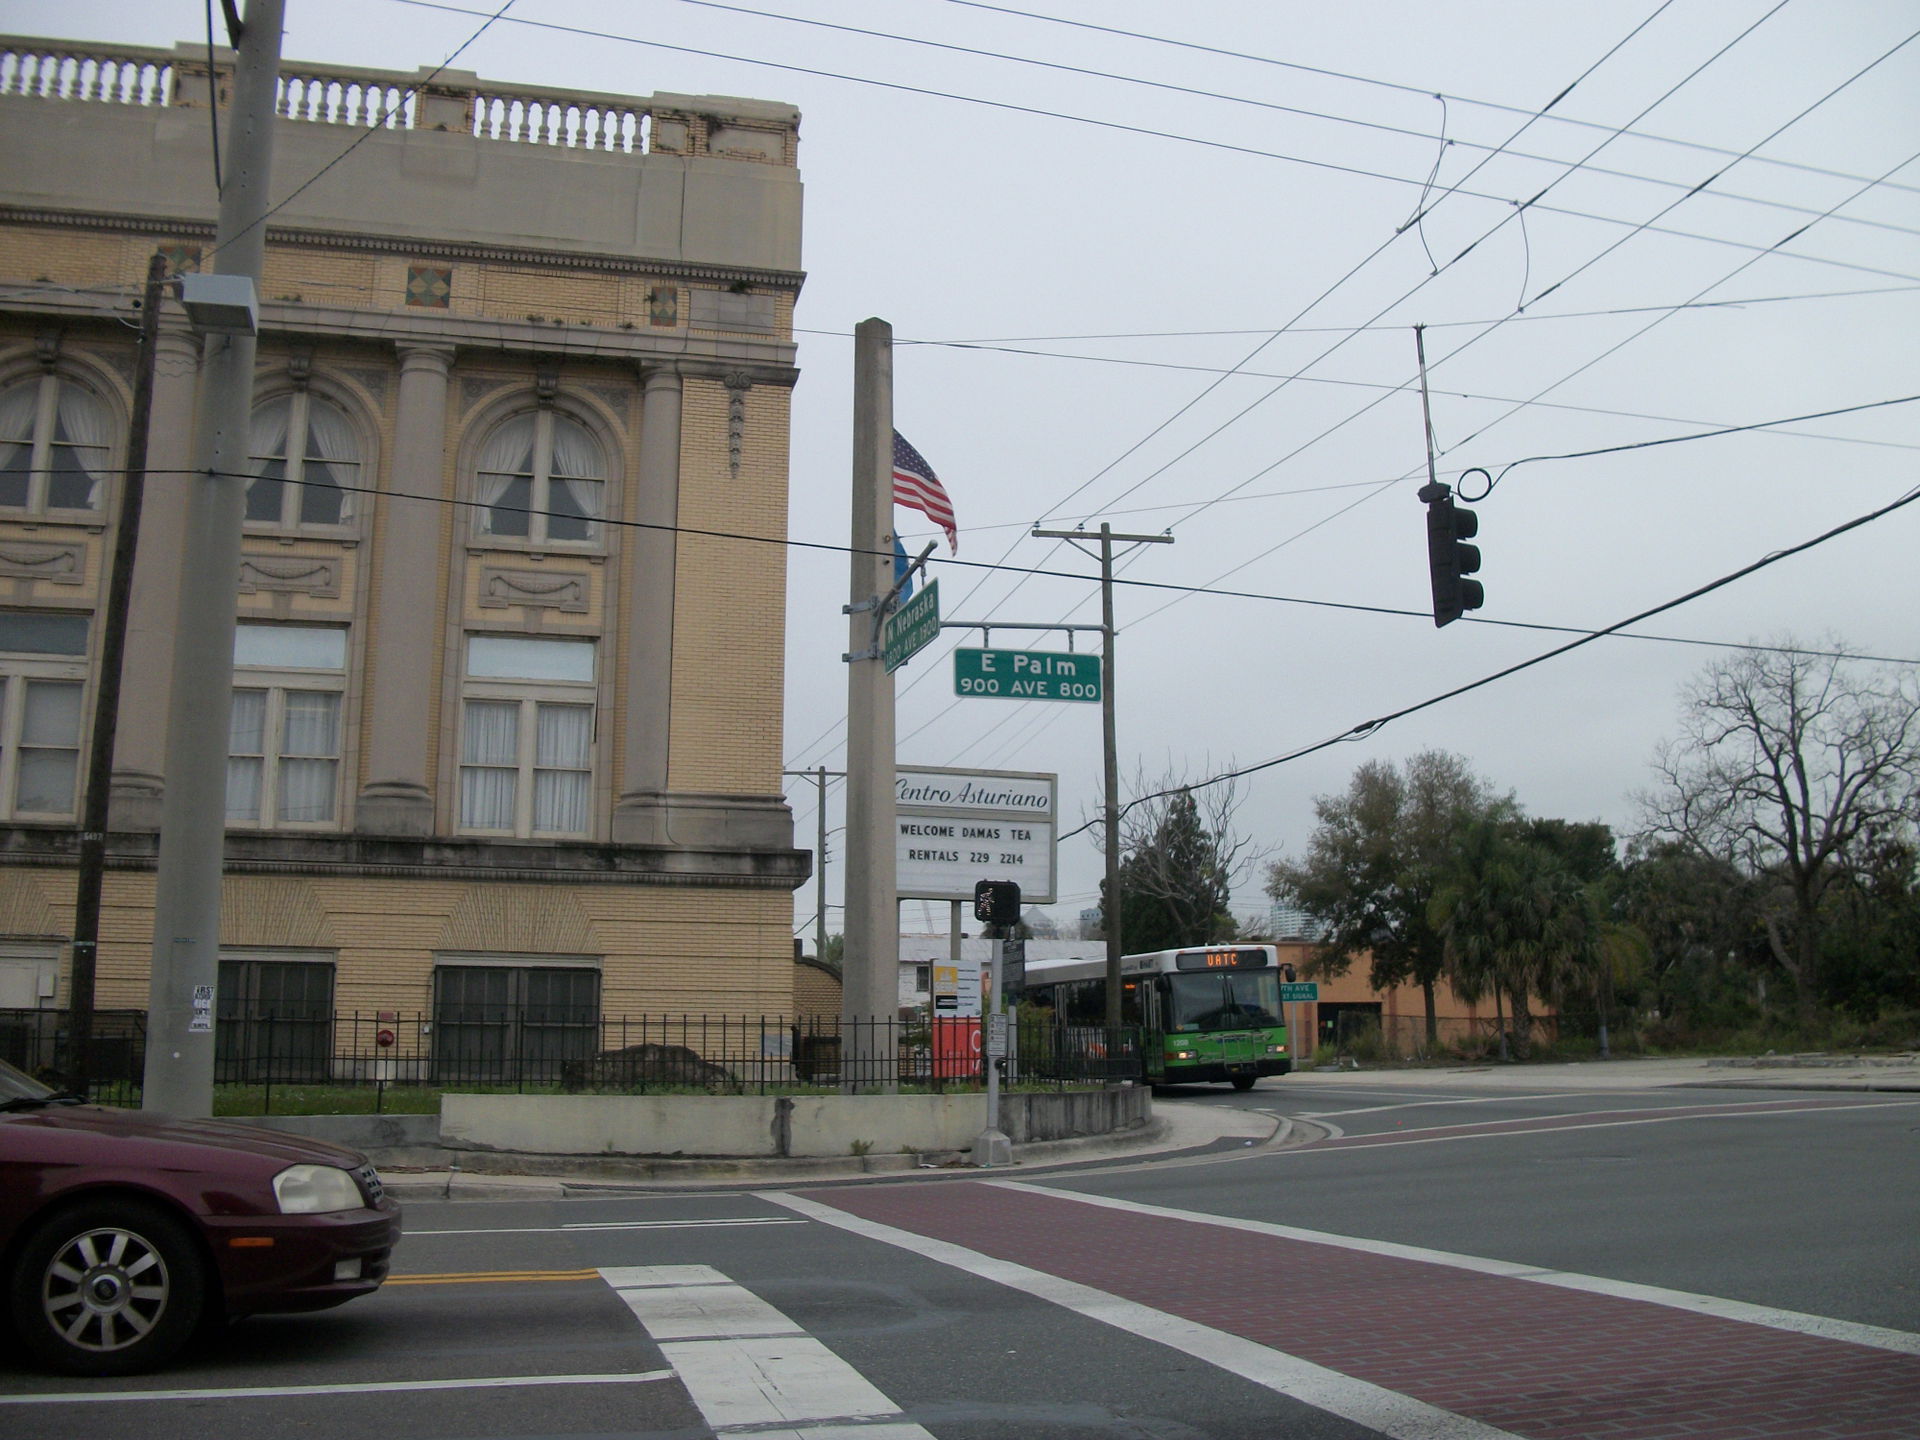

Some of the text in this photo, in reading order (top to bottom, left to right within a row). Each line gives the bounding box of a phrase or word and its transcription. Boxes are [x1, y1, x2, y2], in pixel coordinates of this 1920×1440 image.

[887, 592, 935, 644] N Nebraska
[903, 631, 917, 654] AVE
[919, 616, 937, 640] 1900
[981, 653, 1076, 676] E Palm
[960, 678, 1097, 698] 900 AVE 800
[895, 778, 1048, 808] Centro Asturiano
[900, 824, 1032, 841] WELCOME DAMAS TEA
[909, 849, 1024, 864] RENTALS 229 2214
[1207, 953, 1238, 967] UATC
[1295, 984, 1310, 992] AVE
